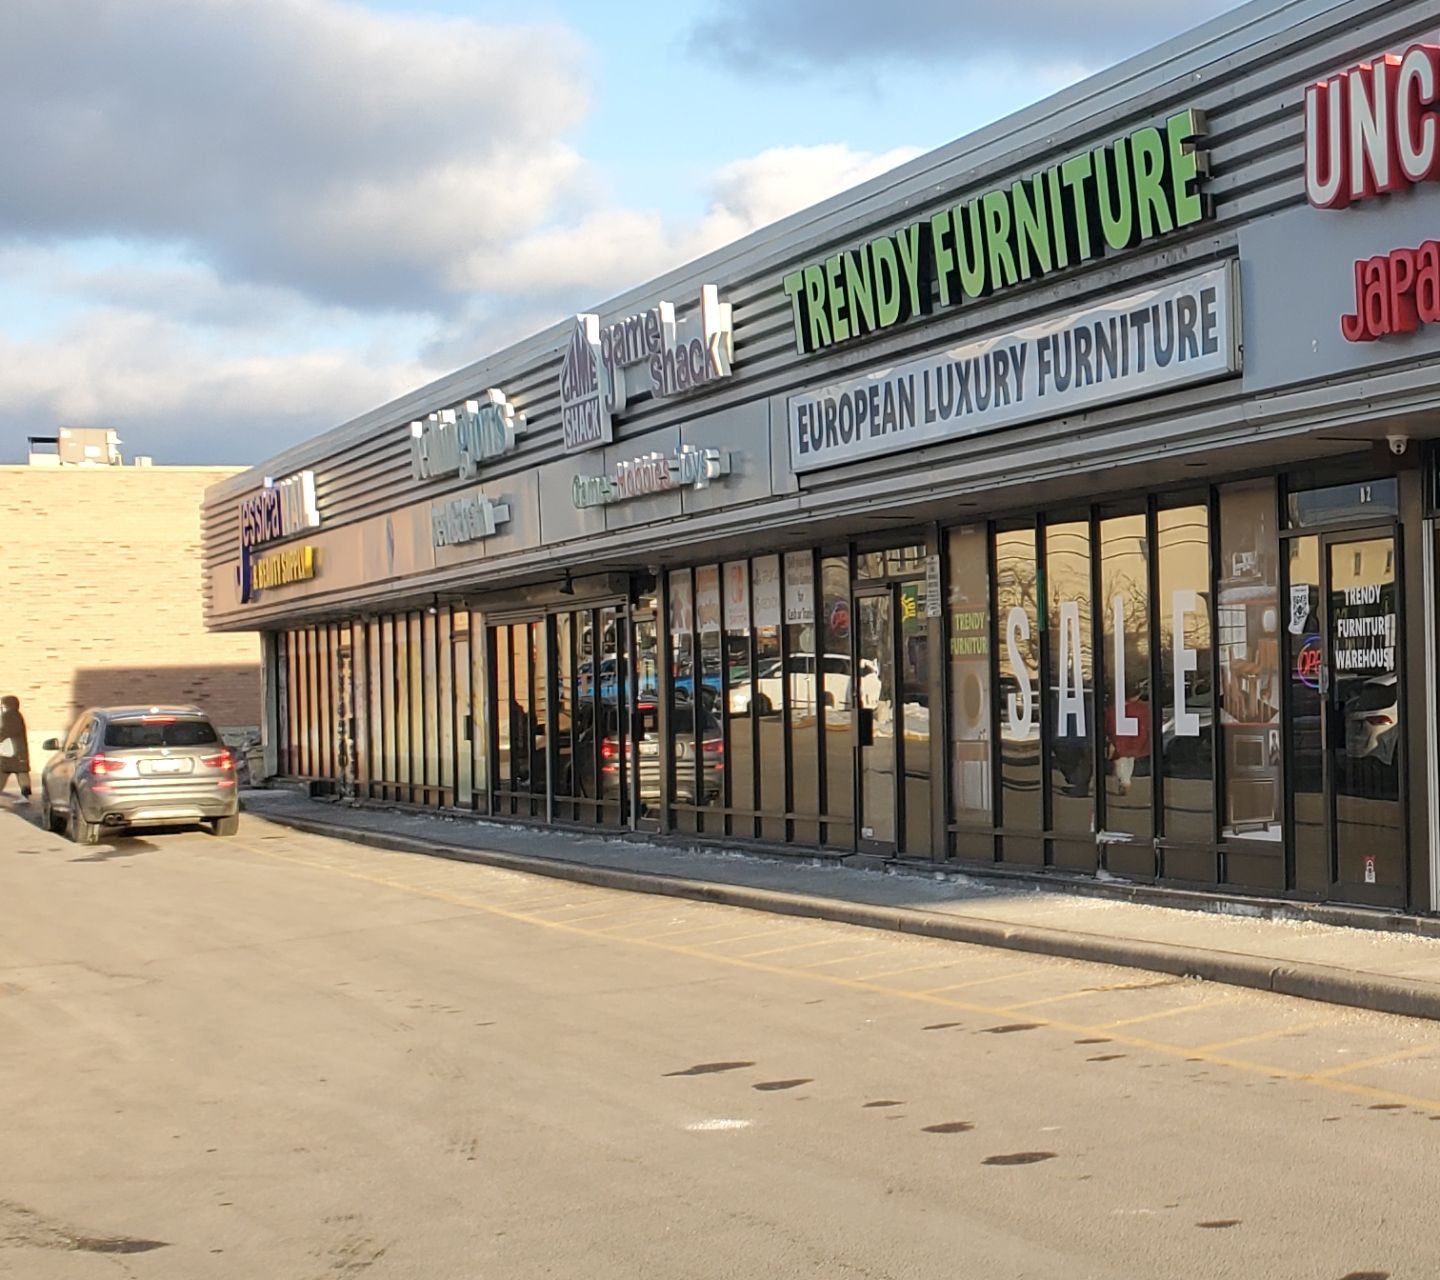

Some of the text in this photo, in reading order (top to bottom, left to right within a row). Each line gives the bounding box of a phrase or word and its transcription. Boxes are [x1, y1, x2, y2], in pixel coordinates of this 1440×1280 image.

[783, 108, 1212, 355] TRENDY FURNITURE
[798, 286, 1218, 454] EUROPEAN LUXURY FURNITURE
[565, 398, 600, 448] SHACK
[1344, 584, 1381, 606] TRENDY
[953, 612, 985, 631] TRENDY
[950, 636, 988, 656] FURNITUR
[1006, 590, 1200, 738] SALE
[1300, 650, 1321, 674] OPE
